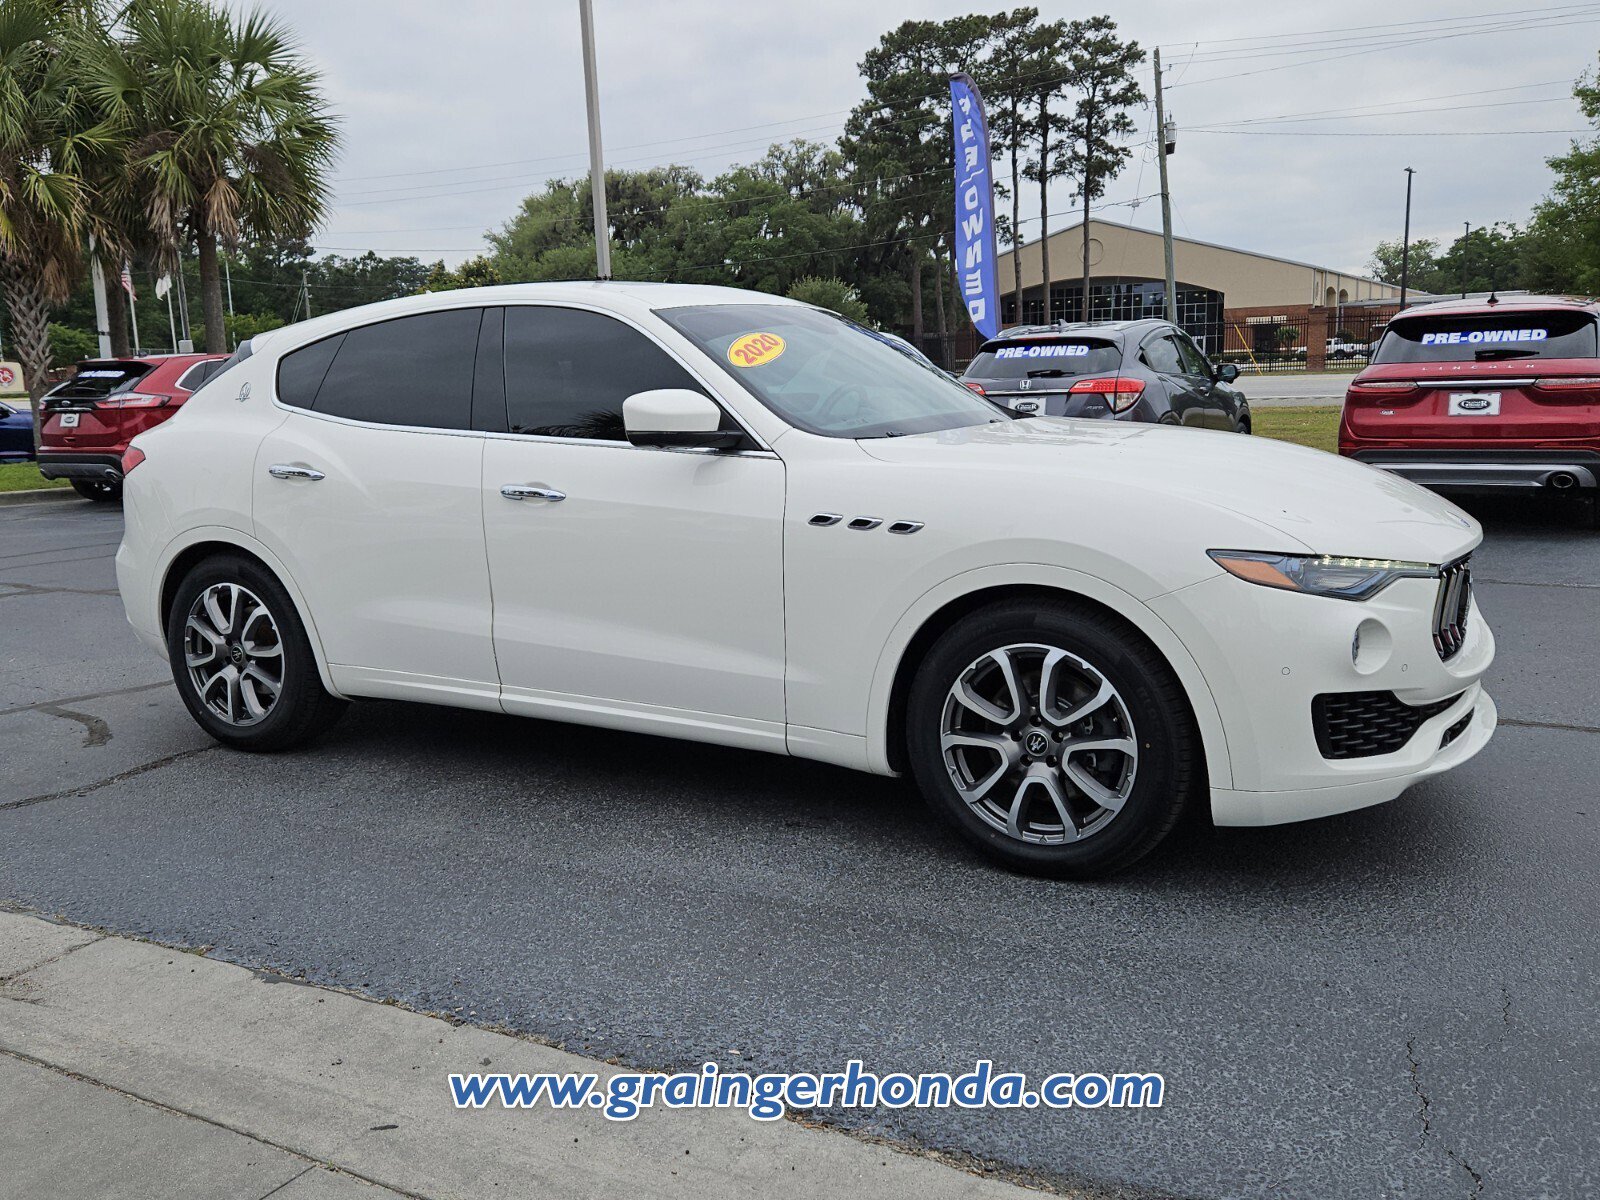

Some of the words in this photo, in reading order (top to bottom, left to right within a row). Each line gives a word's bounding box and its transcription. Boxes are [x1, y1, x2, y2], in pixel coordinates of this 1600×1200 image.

[1421, 328, 1548, 345] PRE-OWNED
[734, 333, 780, 365] 2020
[995, 345, 1090, 359] PRE-OWNED
[1422, 363, 1536, 371] LINCOLN
